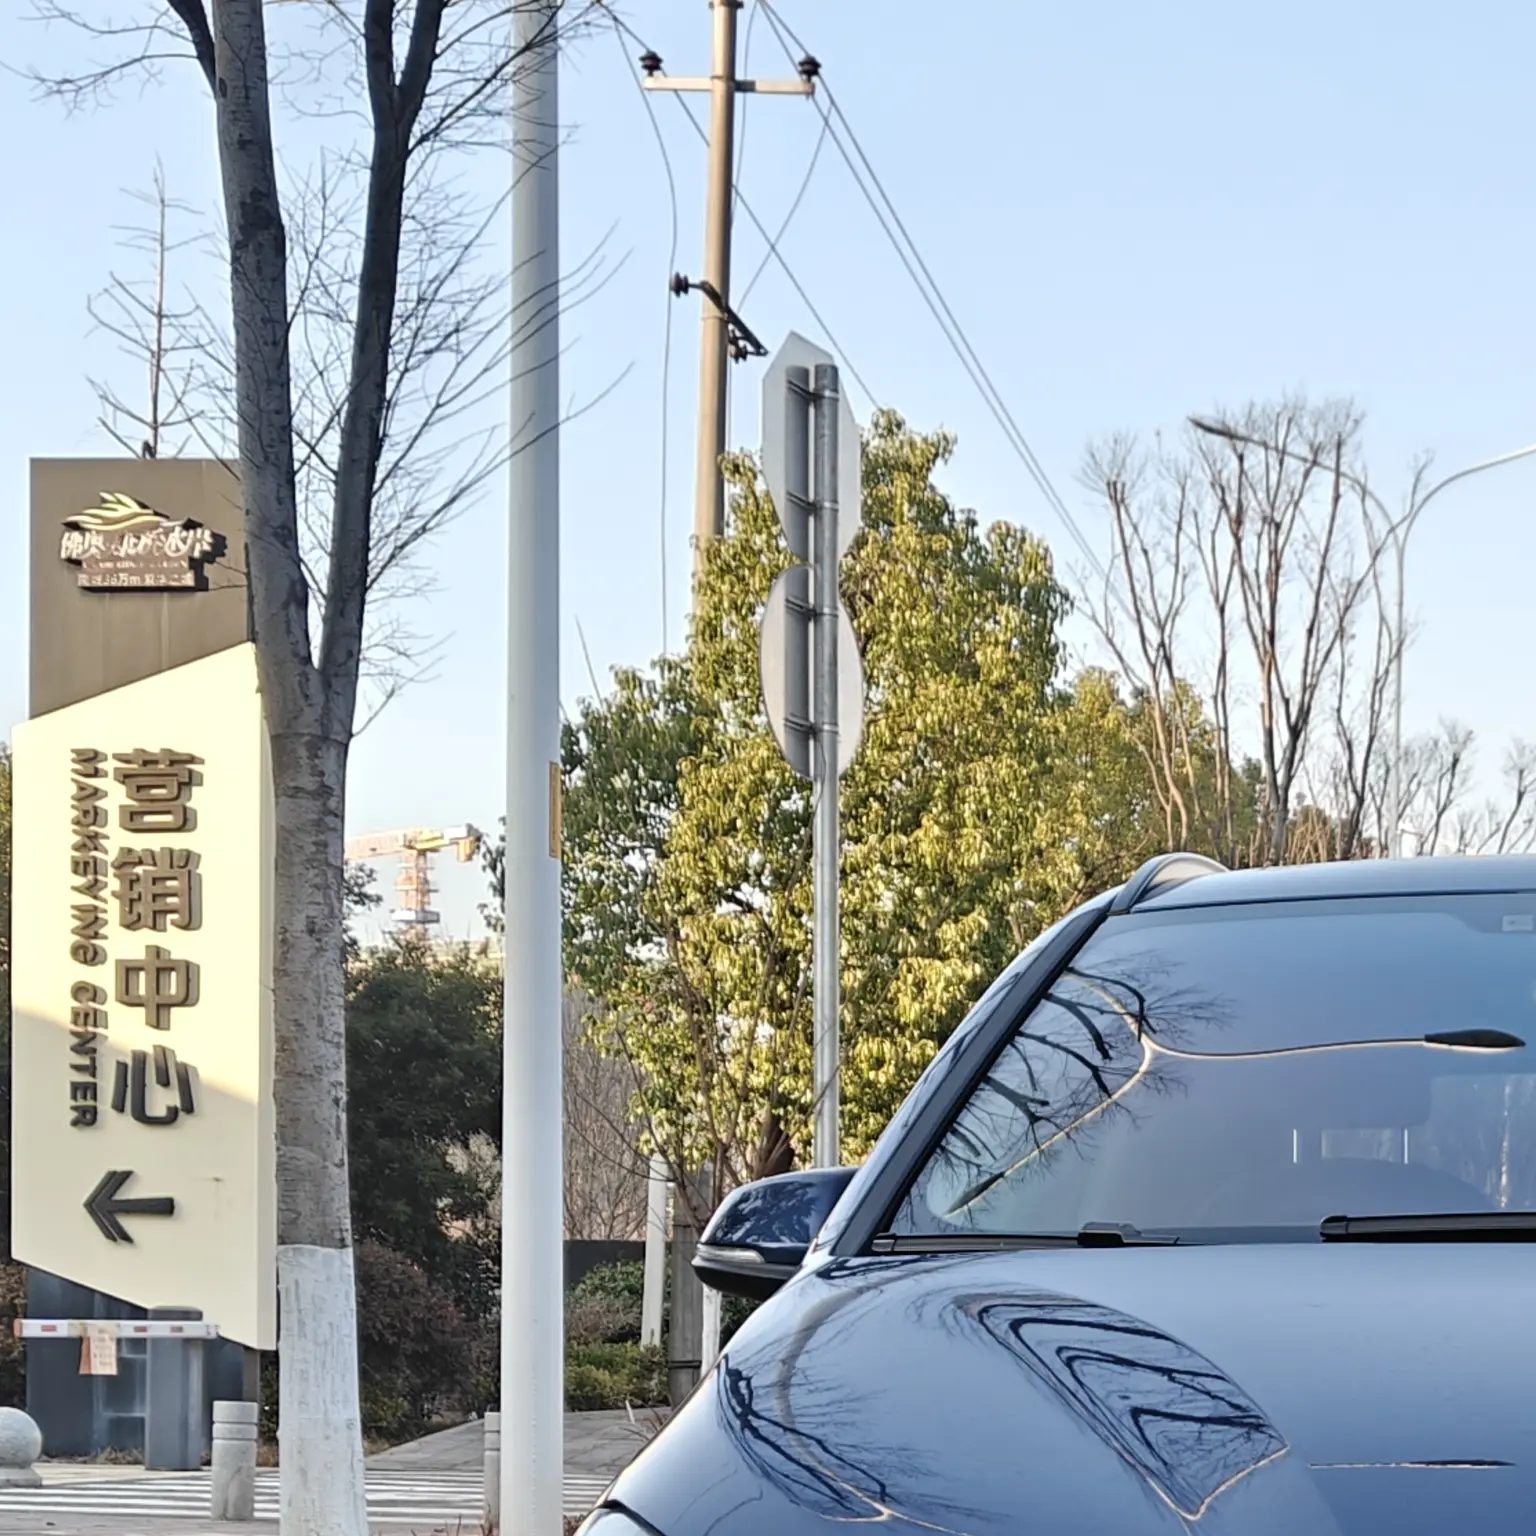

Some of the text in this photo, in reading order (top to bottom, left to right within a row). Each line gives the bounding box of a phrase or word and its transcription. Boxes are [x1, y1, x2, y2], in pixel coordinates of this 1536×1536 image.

[70, 980, 107, 1126] CENTER
[110, 748, 204, 1125] 营销中心
